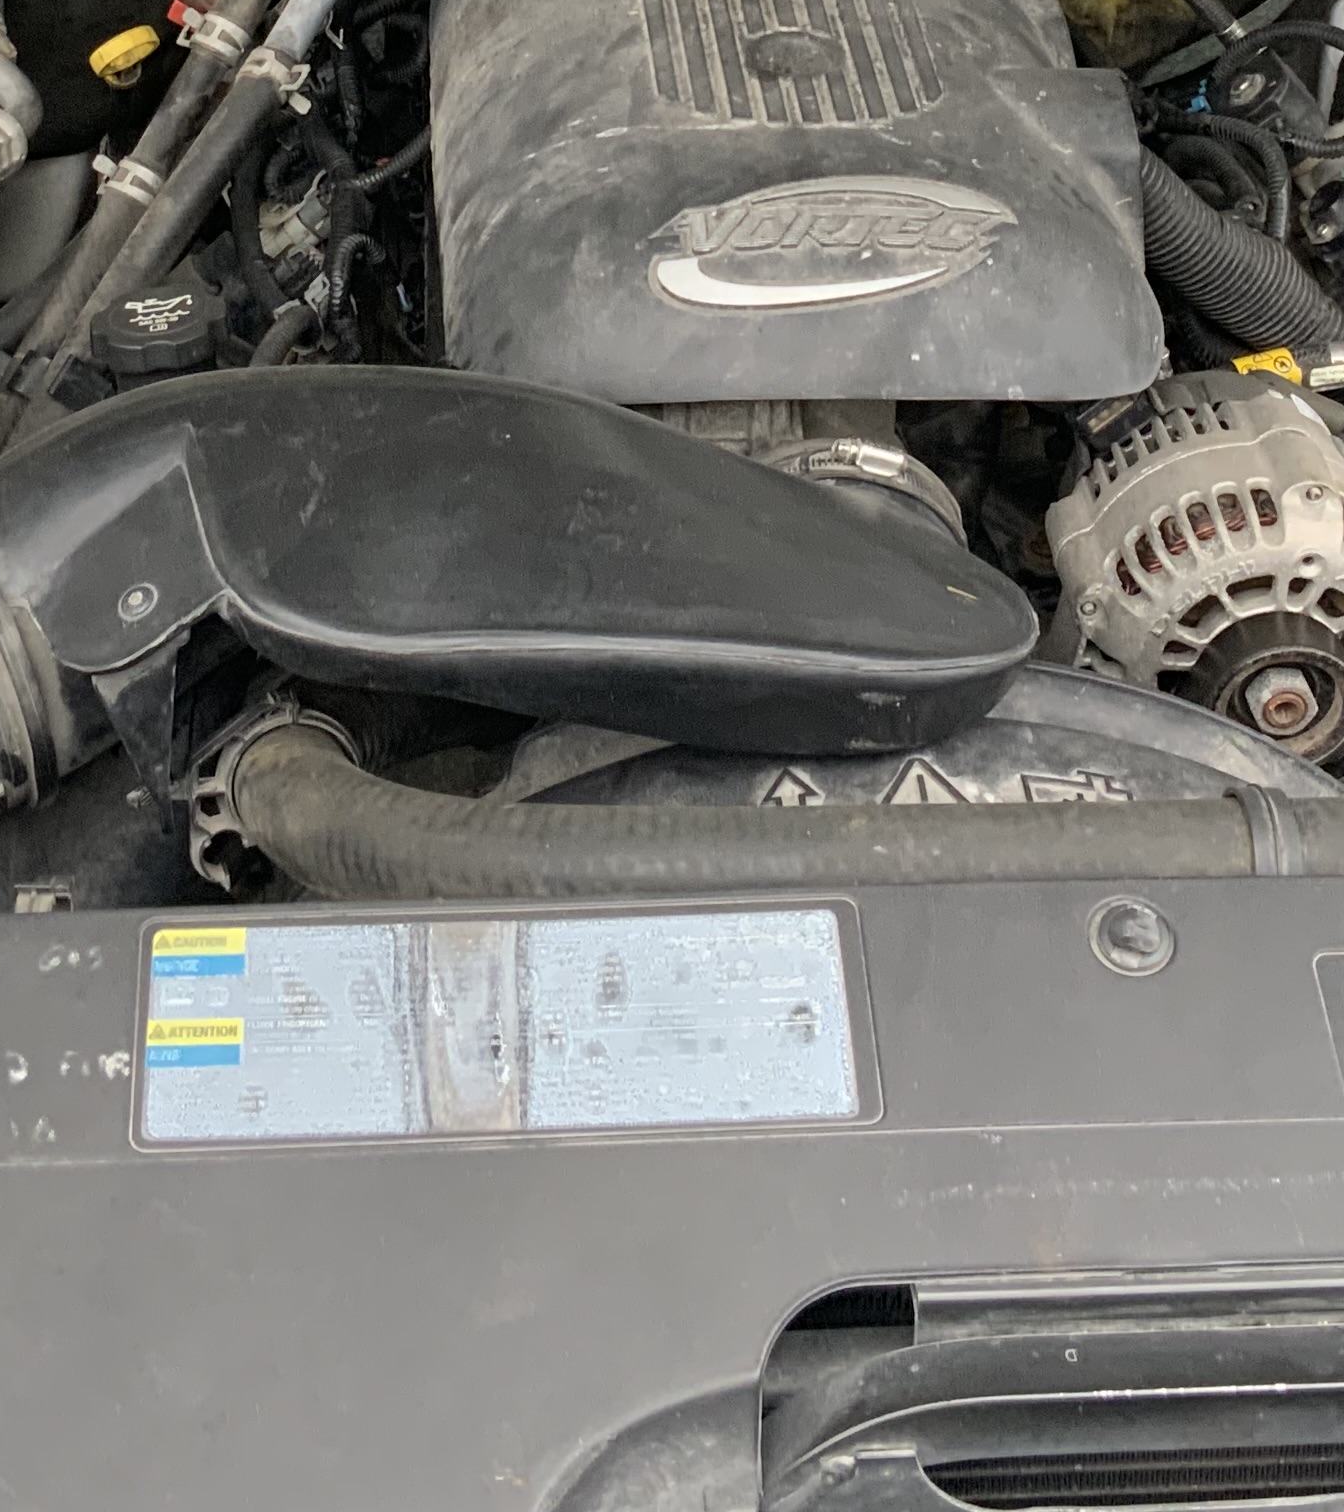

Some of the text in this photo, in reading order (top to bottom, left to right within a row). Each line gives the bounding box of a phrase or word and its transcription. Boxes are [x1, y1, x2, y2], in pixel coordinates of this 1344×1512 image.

[684, 206, 991, 256] VORTEC
[1151, 558, 1256, 637] DELPHI
[173, 935, 228, 949] CAUTION
[167, 1024, 239, 1039] ATTENTION
